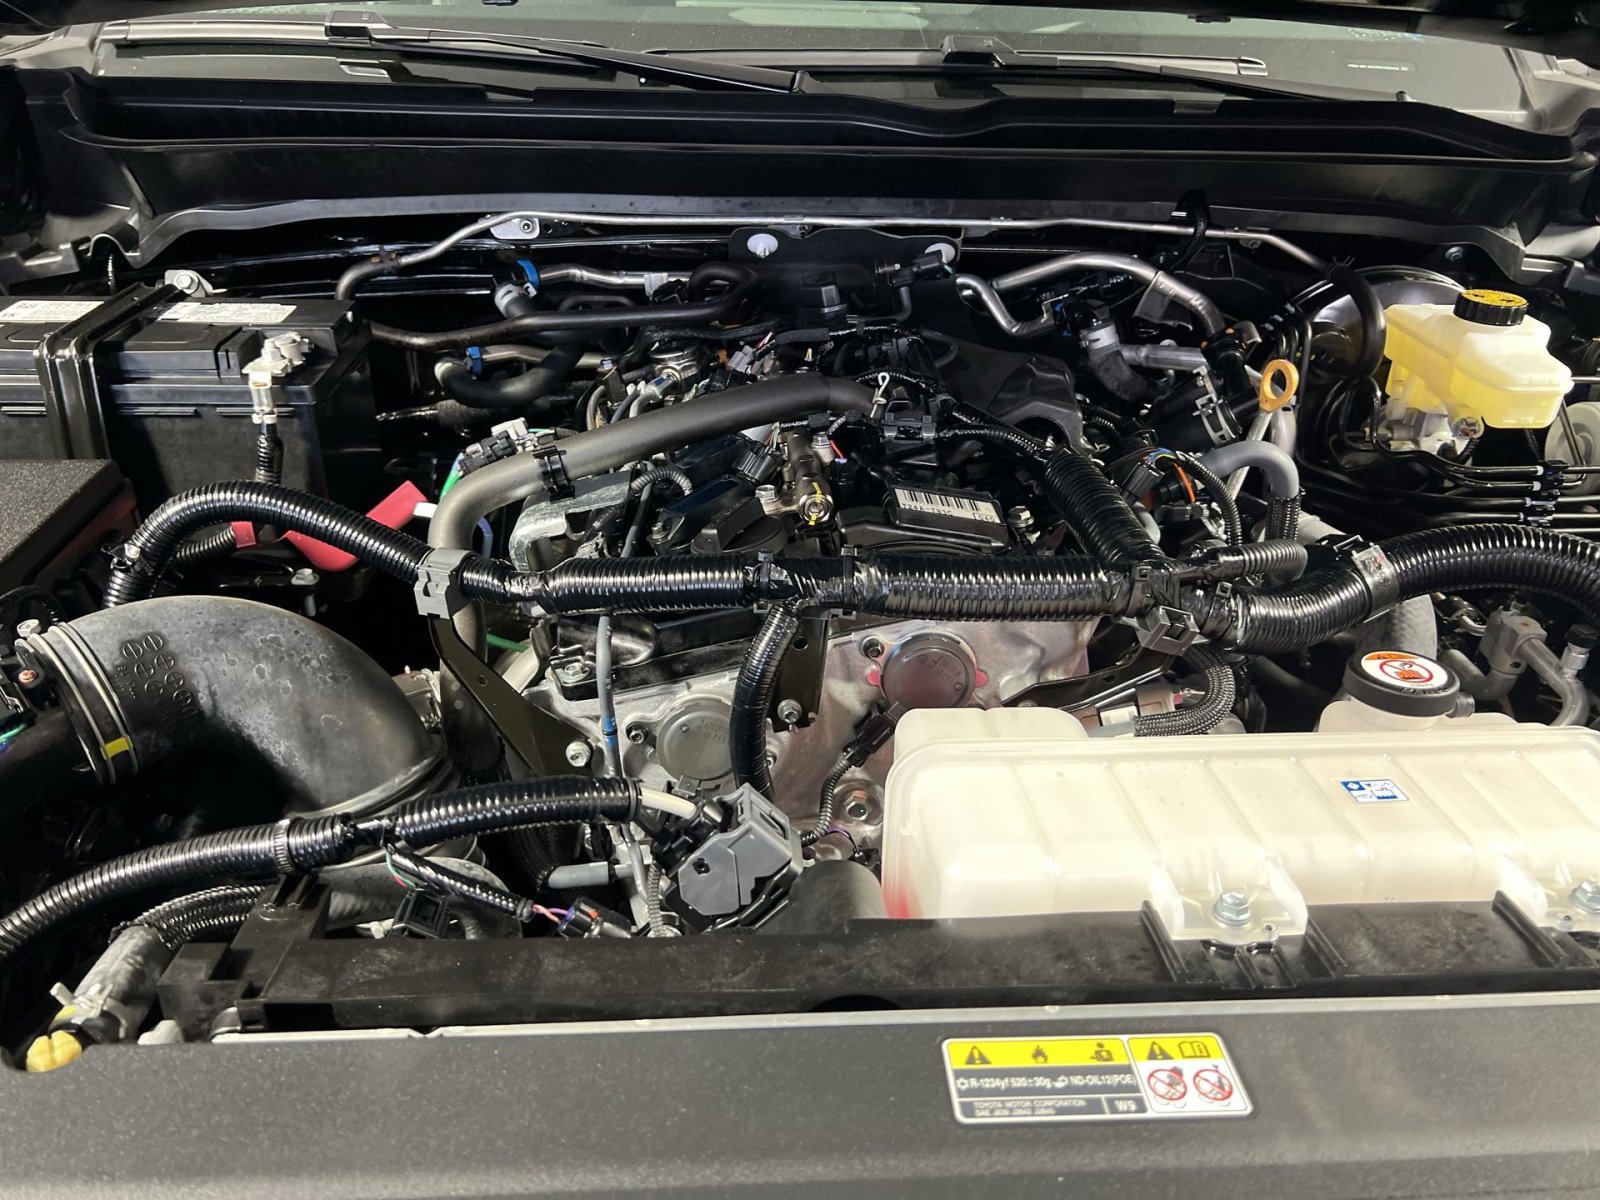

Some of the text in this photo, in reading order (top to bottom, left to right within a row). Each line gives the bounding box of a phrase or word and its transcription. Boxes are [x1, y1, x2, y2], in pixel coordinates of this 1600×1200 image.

[969, 1076, 1009, 1091] R-1234yf
[973, 1098, 1087, 1109] TOYOTA MOTOR CORPORATION
[1114, 1099, 1137, 1112] W9
